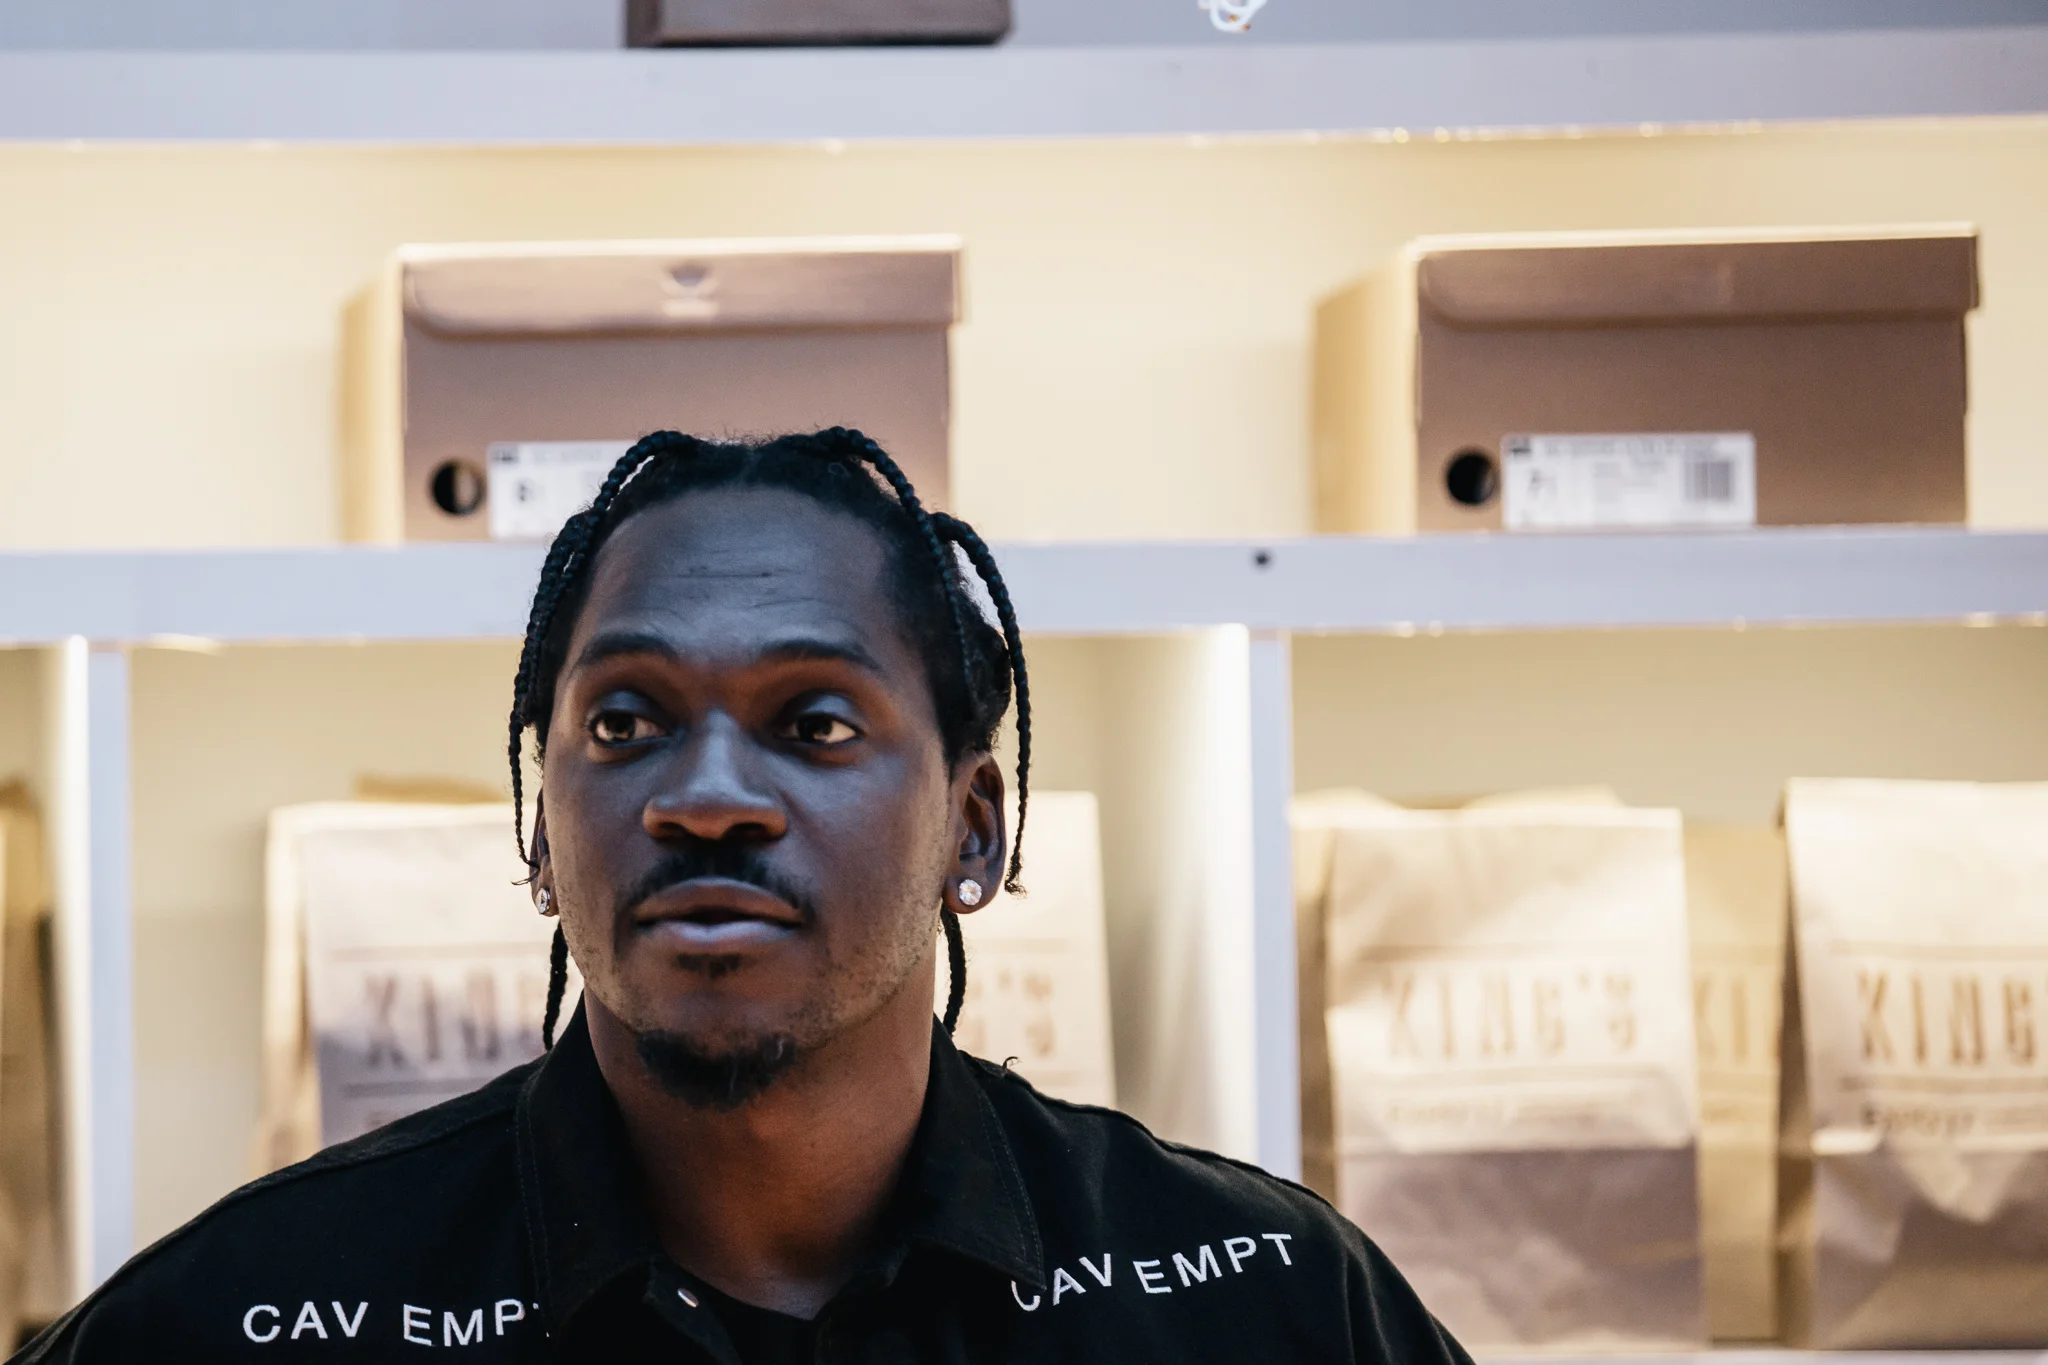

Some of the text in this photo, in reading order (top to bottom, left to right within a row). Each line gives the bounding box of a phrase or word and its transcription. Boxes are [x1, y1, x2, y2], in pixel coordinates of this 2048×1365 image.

[1132, 1233, 1292, 1294] EMPT
[242, 1298, 550, 1347] CAV EMP
